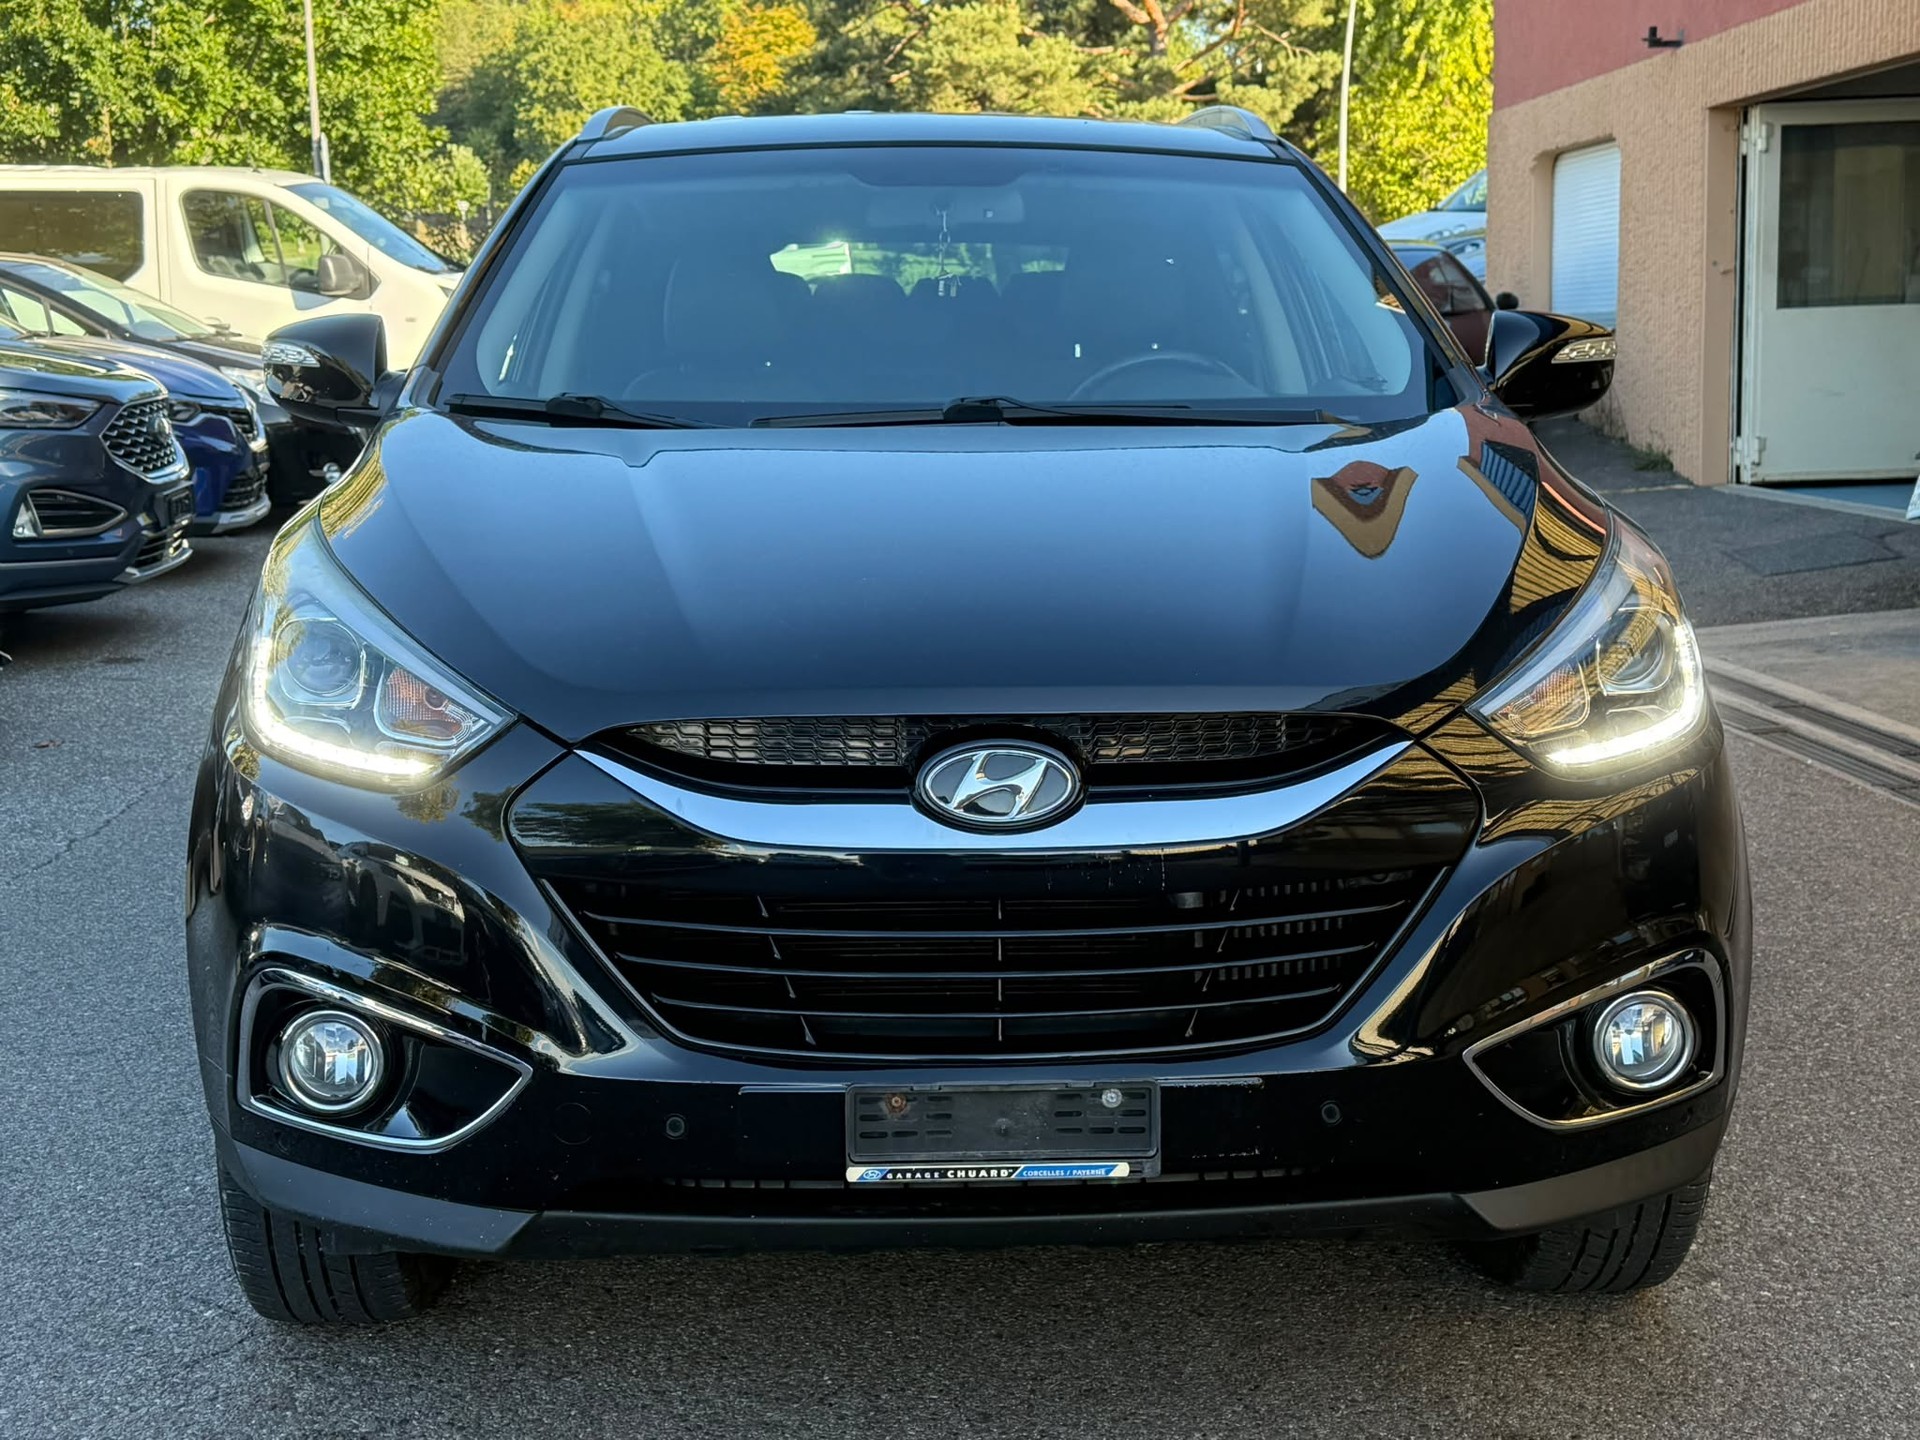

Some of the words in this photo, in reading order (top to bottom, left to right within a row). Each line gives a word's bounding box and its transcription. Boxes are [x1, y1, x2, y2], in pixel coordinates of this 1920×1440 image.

[886, 1171, 940, 1179] GARAGE
[946, 1169, 1009, 1178] CHUARD
[1022, 1169, 1065, 1177] CORCELLES
[1072, 1168, 1106, 1176] PAYERNE
